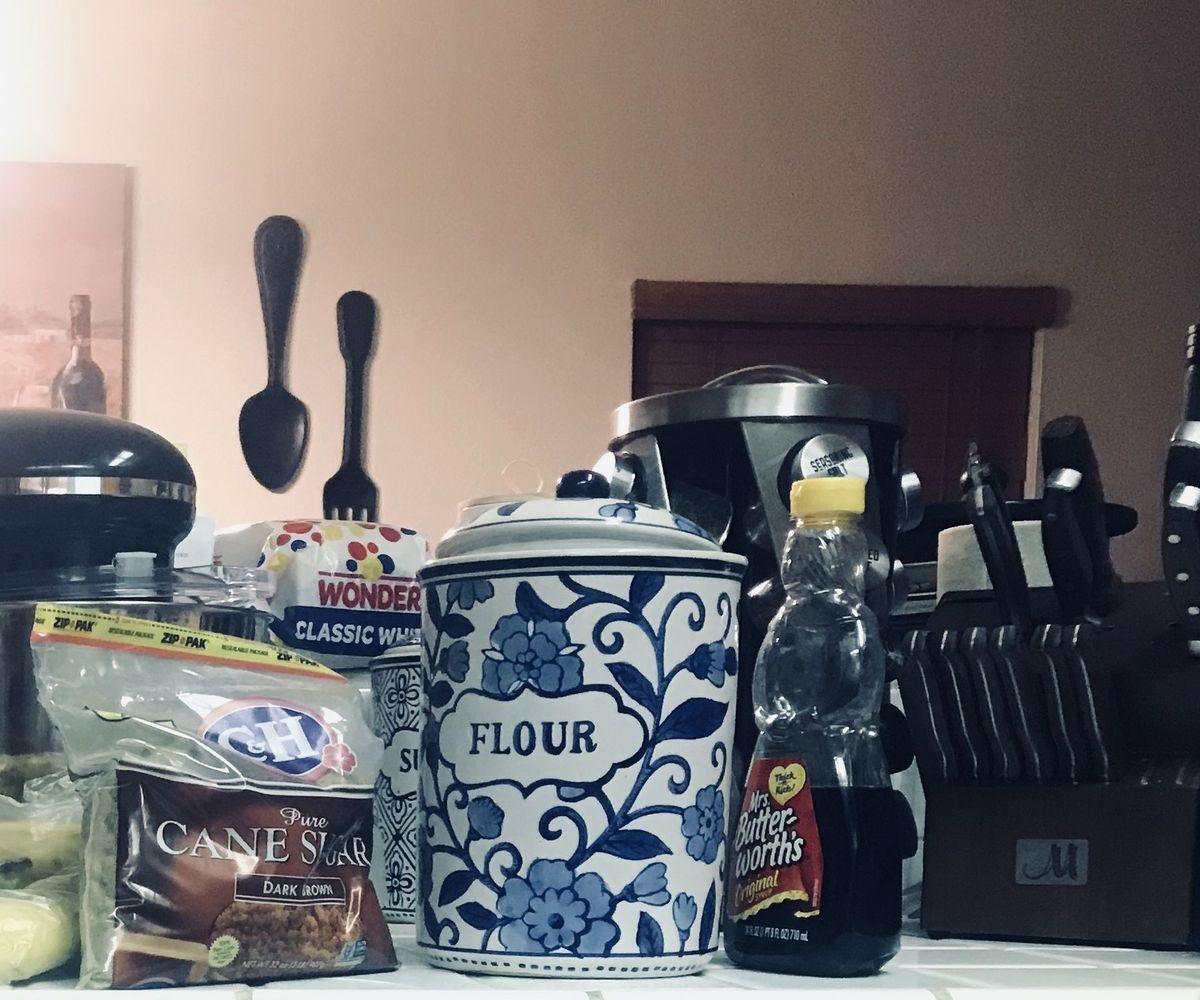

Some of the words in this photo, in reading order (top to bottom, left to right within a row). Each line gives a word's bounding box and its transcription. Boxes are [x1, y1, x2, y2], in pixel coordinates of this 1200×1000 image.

[318, 579, 421, 611] WONDER
[53, 616, 70, 629] ZIP
[75, 619, 94, 632] PAK
[295, 620, 375, 645] CLASSIC
[161, 632, 180, 645] ZIP
[185, 636, 207, 650] PAK
[469, 720, 598, 756] FLOUR
[749, 789, 770, 812] Mrs.
[280, 807, 329, 829] Pure
[156, 820, 289, 864] CANE
[735, 869, 779, 908] Original
